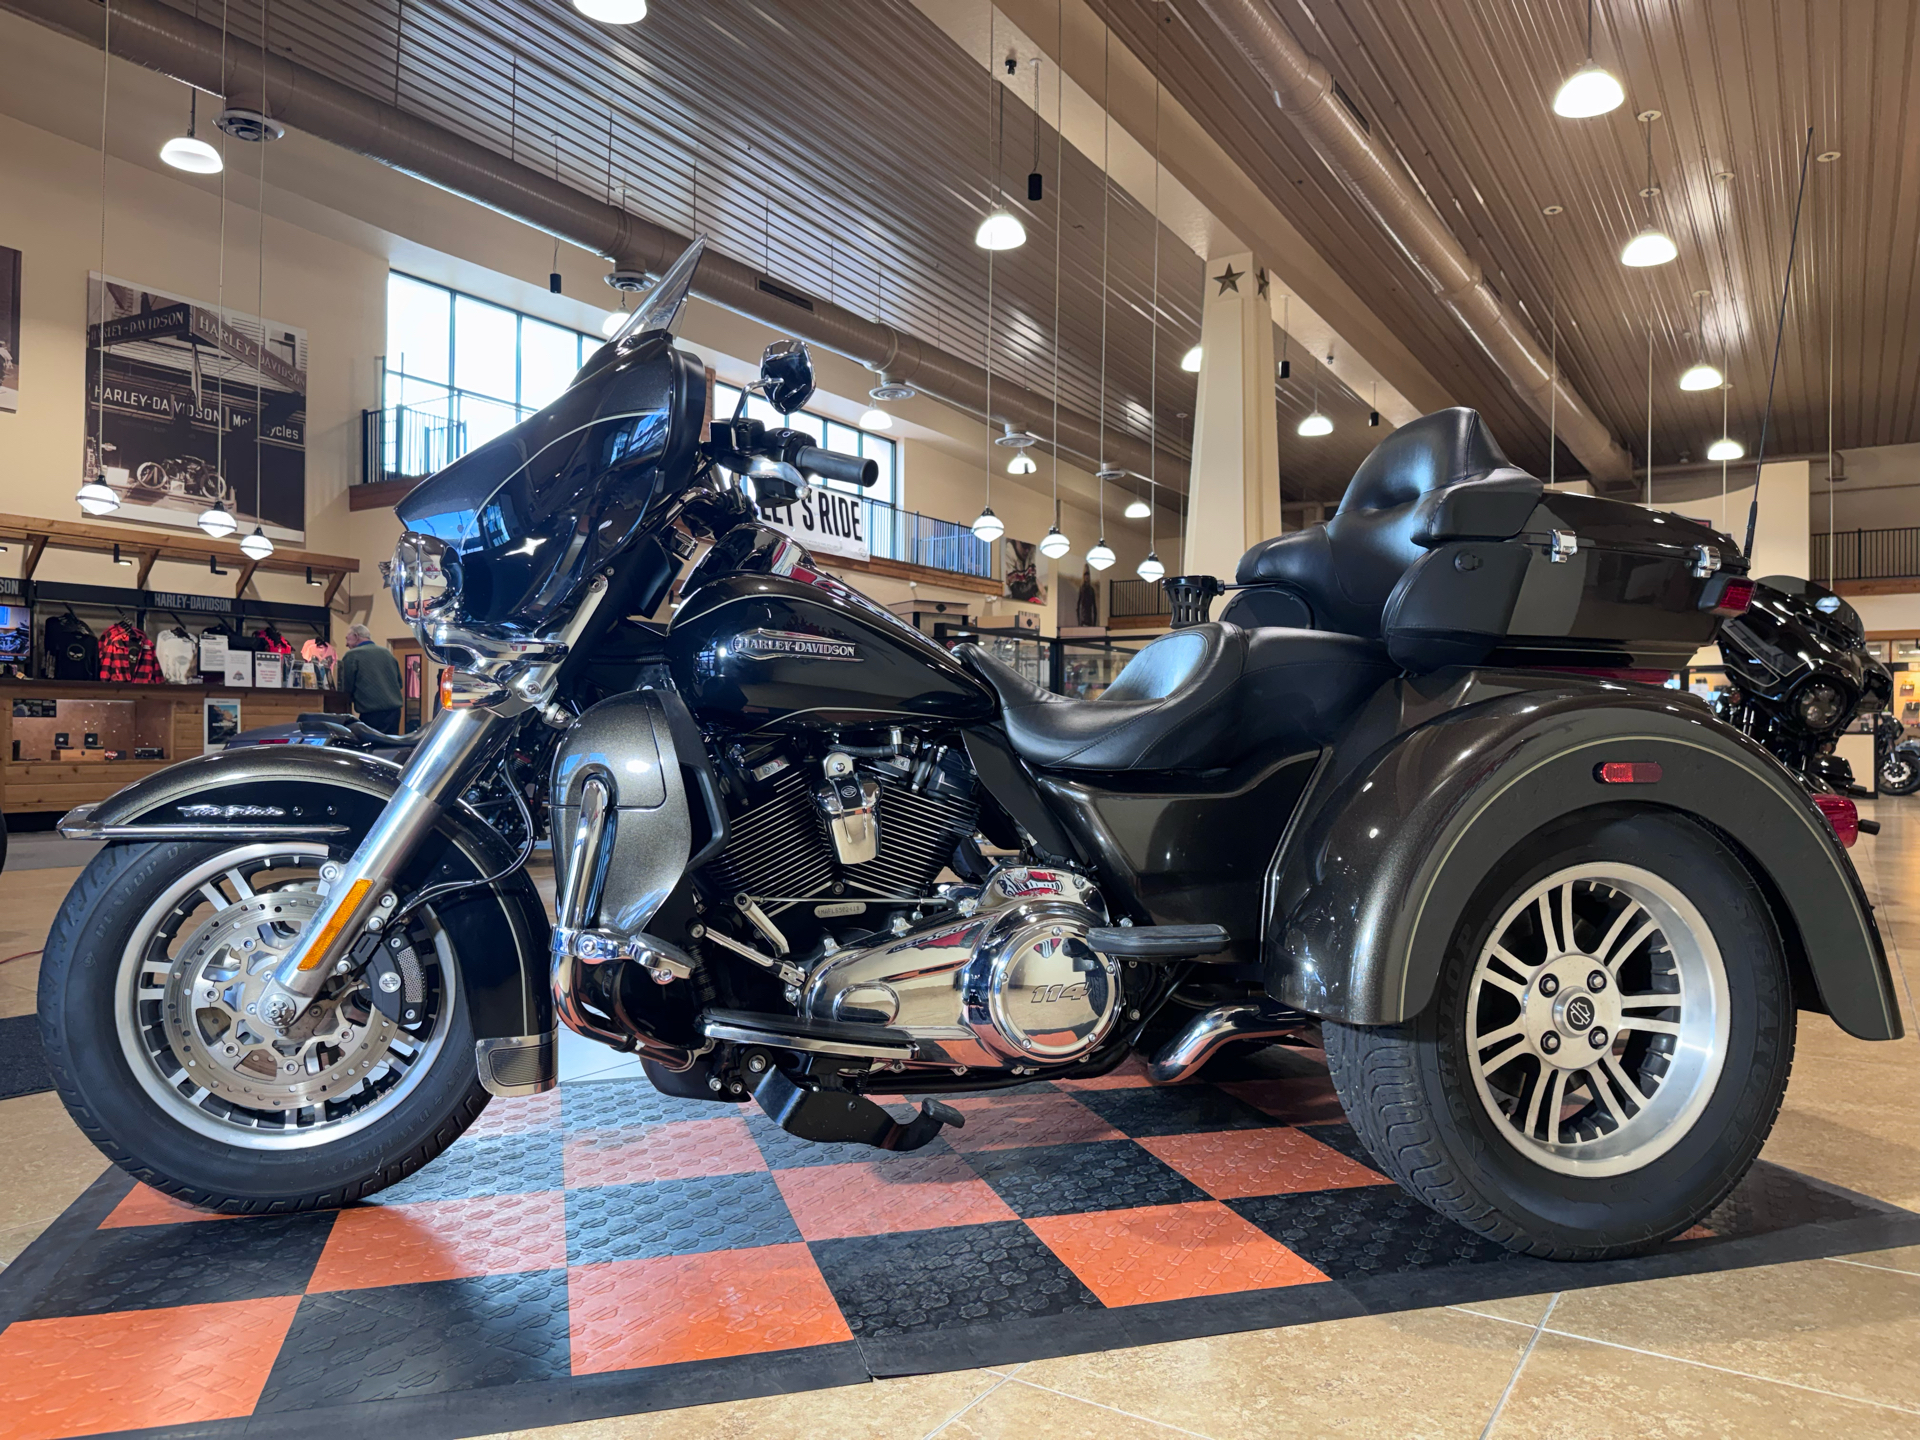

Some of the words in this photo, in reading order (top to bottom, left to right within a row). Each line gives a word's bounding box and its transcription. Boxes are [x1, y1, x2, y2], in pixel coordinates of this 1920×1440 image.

[200, 315, 305, 388] HARLEY-DAVIDSON
[94, 385, 220, 423] HARLEY-DAVIDSON
[818, 491, 863, 542] RIDE
[154, 593, 231, 612] HARLEY-DAVIDSON
[739, 637, 855, 657] HARLEY-DAVIDSON
[1031, 981, 1092, 1003] 114
[1438, 923, 1472, 1121] DUNLOP
